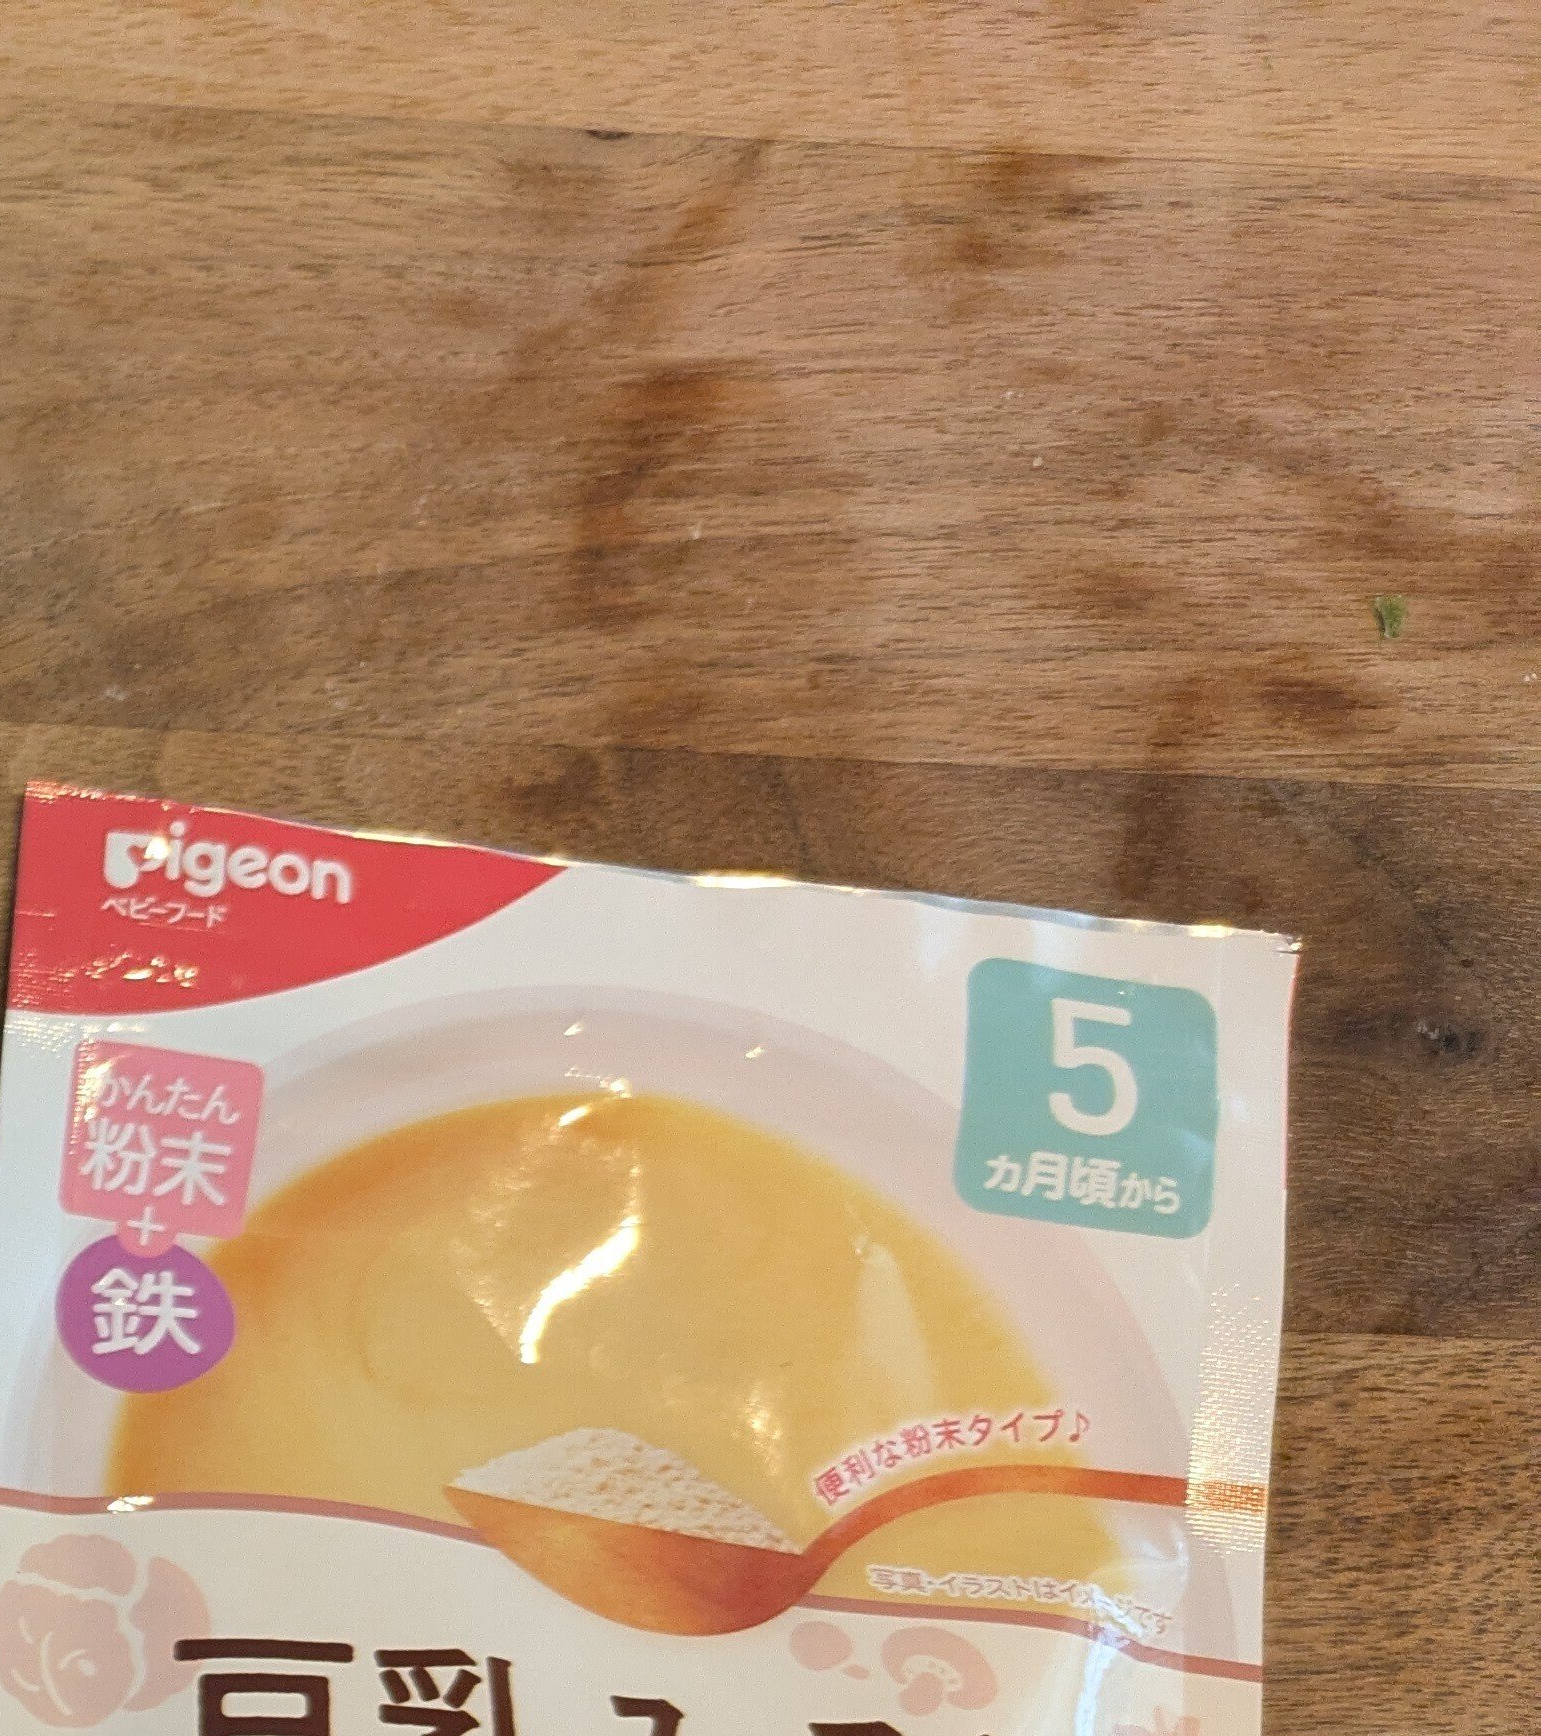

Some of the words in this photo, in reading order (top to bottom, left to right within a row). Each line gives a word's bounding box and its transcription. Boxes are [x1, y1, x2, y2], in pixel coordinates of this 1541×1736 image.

[103, 821, 354, 906] Pigeon
[100, 895, 228, 930] ベビーフード
[1047, 997, 1138, 1137] 5
[79, 1115, 233, 1206] 粉末
[91, 1266, 204, 1356] 鉄
